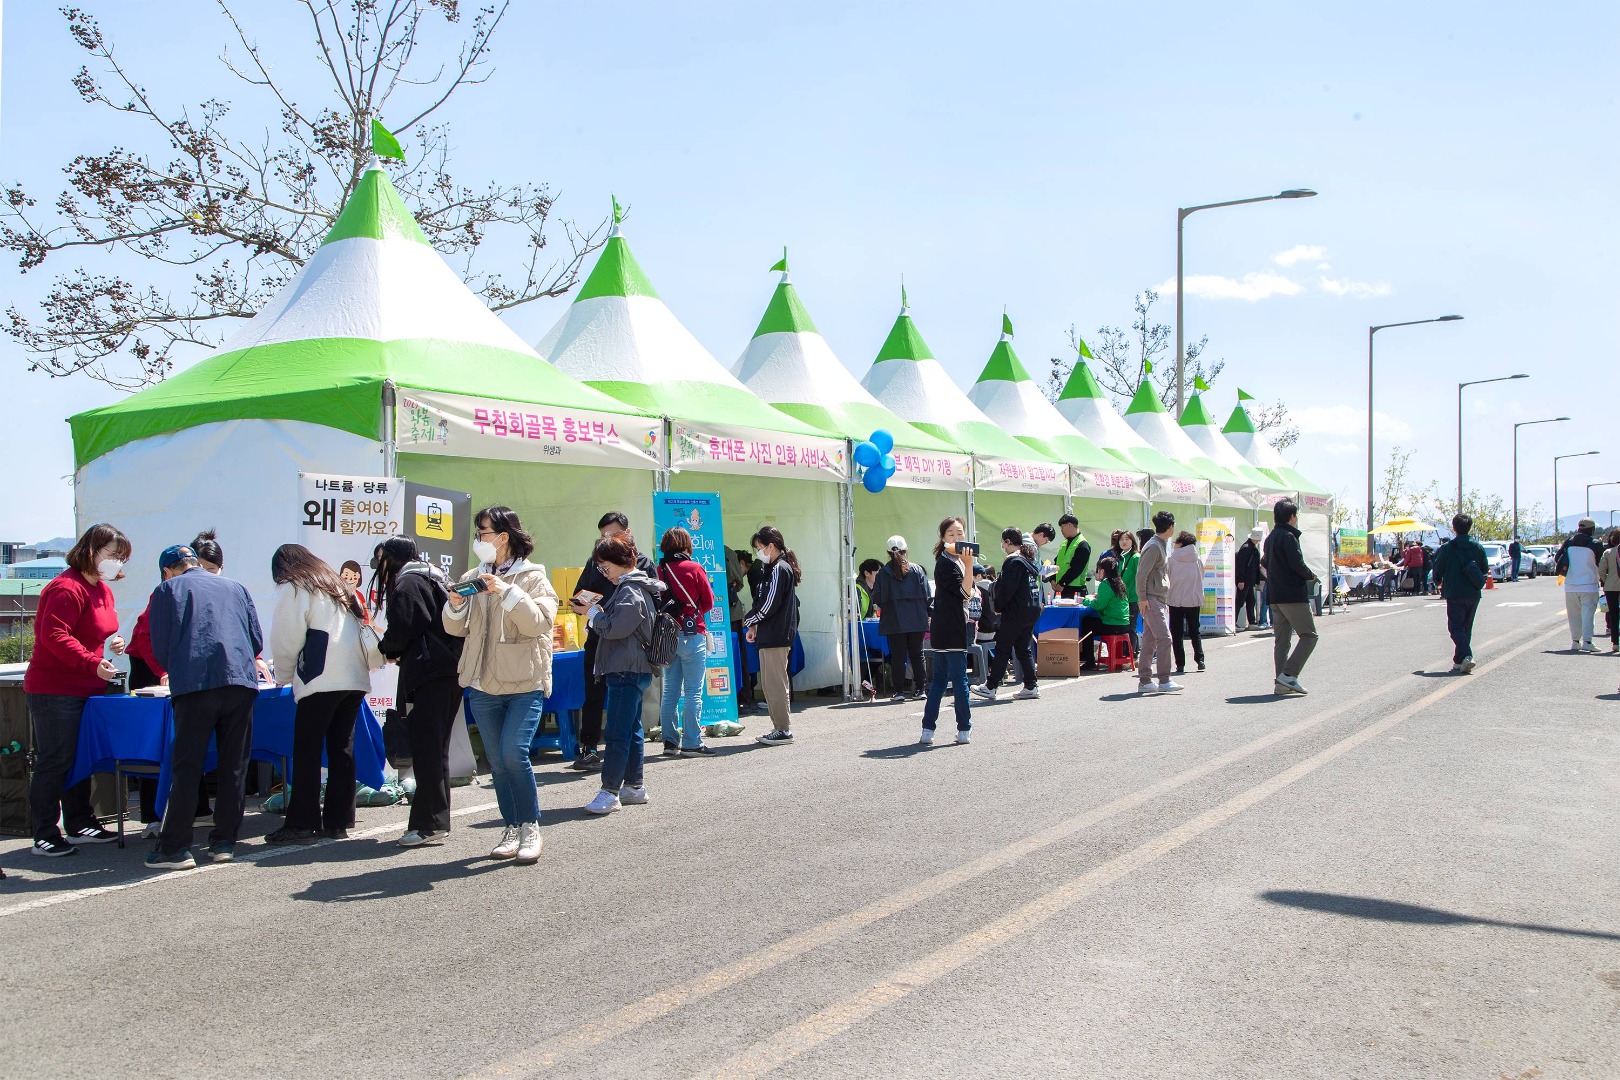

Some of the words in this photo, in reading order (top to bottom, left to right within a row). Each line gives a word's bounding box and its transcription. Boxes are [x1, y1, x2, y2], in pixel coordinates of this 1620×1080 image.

[473, 408, 557, 441] 무침회골목
[563, 417, 621, 445] 홍보부스
[543, 445, 561, 456] 위생과
[709, 437, 746, 462] 휴대폰
[750, 442, 772, 464] 사진
[775, 444, 797, 467] 인화
[800, 447, 829, 469] 서비스
[922, 458, 934, 472] DIY
[937, 458, 952, 476] 키링
[302, 498, 336, 532] 왜
[339, 499, 389, 517] 줄여야
[339, 519, 398, 537] 할까요?
[369, 697, 393, 707] 문제점
